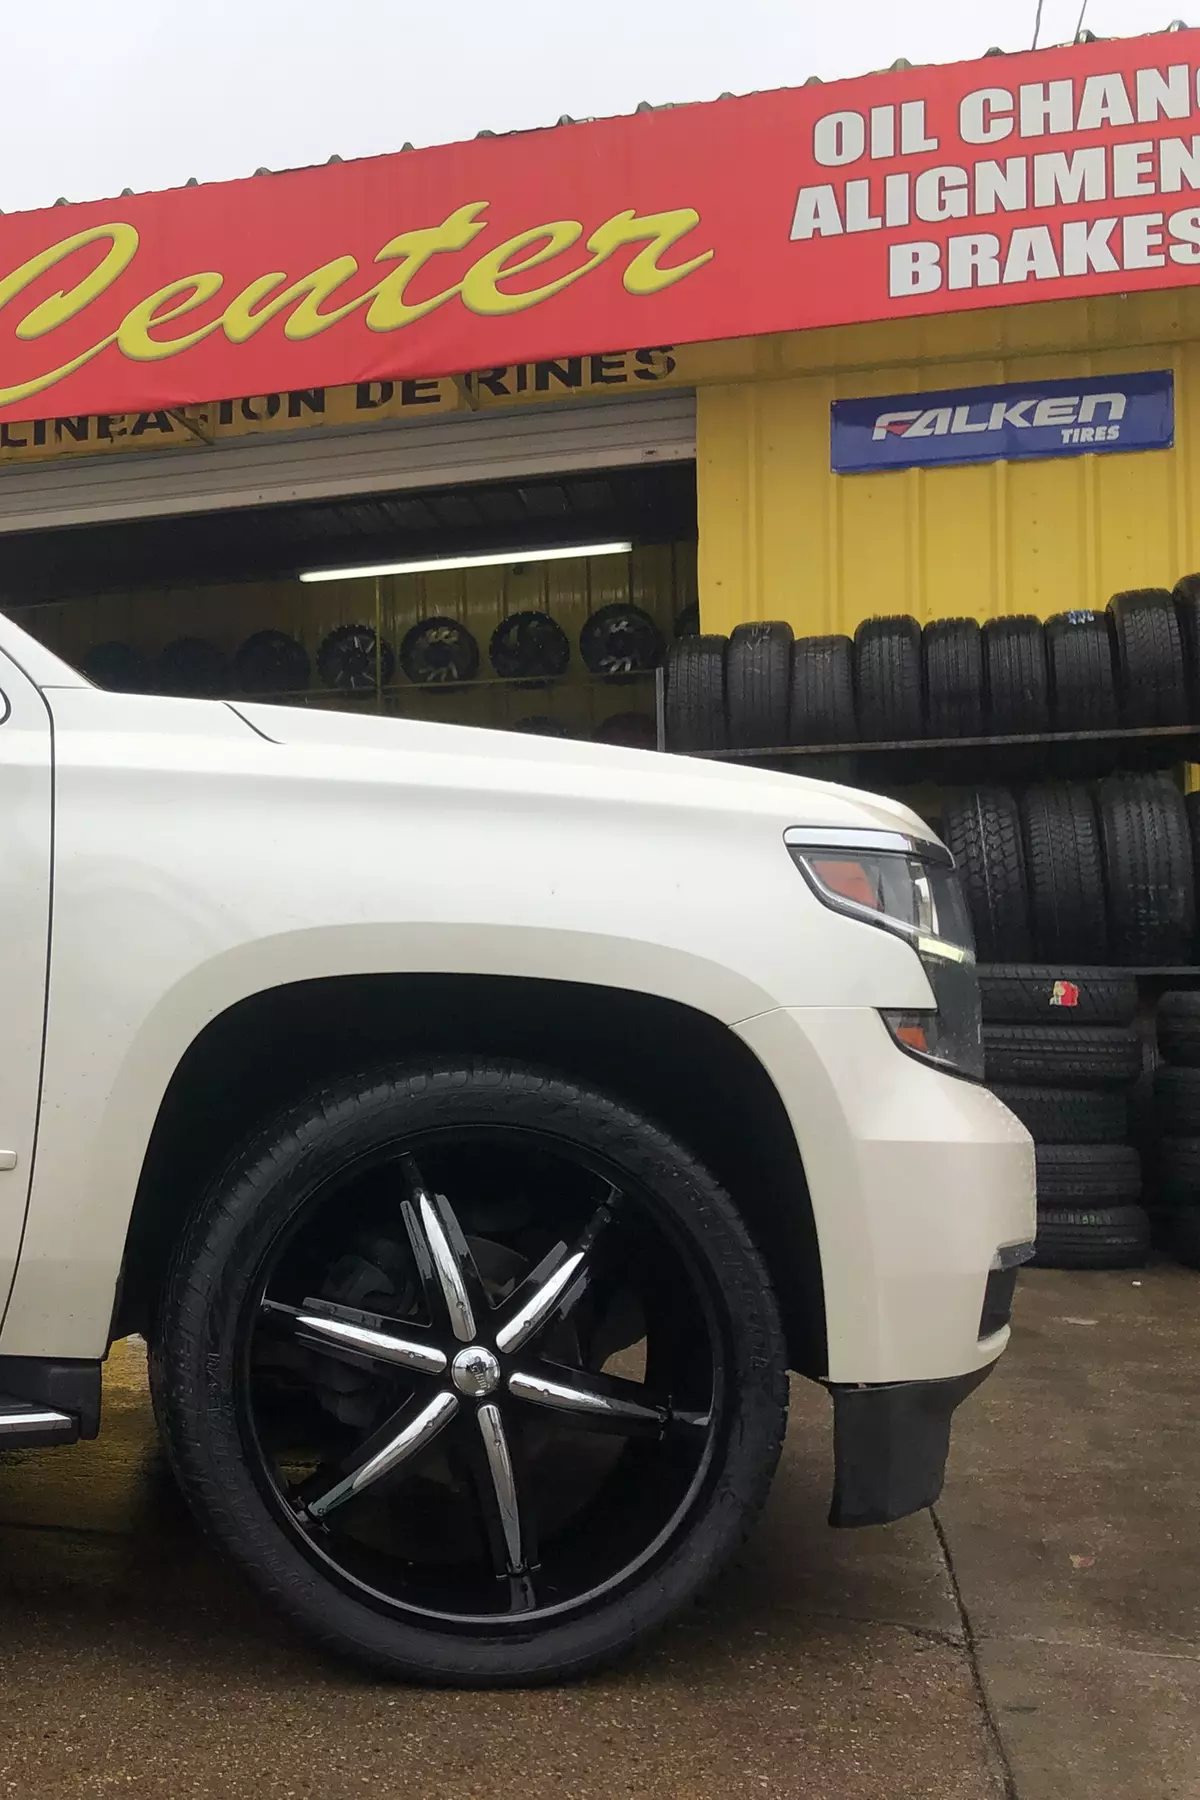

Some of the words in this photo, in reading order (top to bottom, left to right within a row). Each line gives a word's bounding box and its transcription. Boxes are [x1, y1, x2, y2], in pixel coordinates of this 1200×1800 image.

[813, 100, 938, 166] OIL
[960, 64, 1200, 145] CHAN
[790, 136, 1200, 241] ALIGNMEN
[889, 207, 1200, 298] BRAKES
[356, 379, 442, 409] DE
[464, 345, 676, 396] RINES
[872, 392, 1127, 441] FALKEN
[1061, 425, 1120, 444] TIRES
